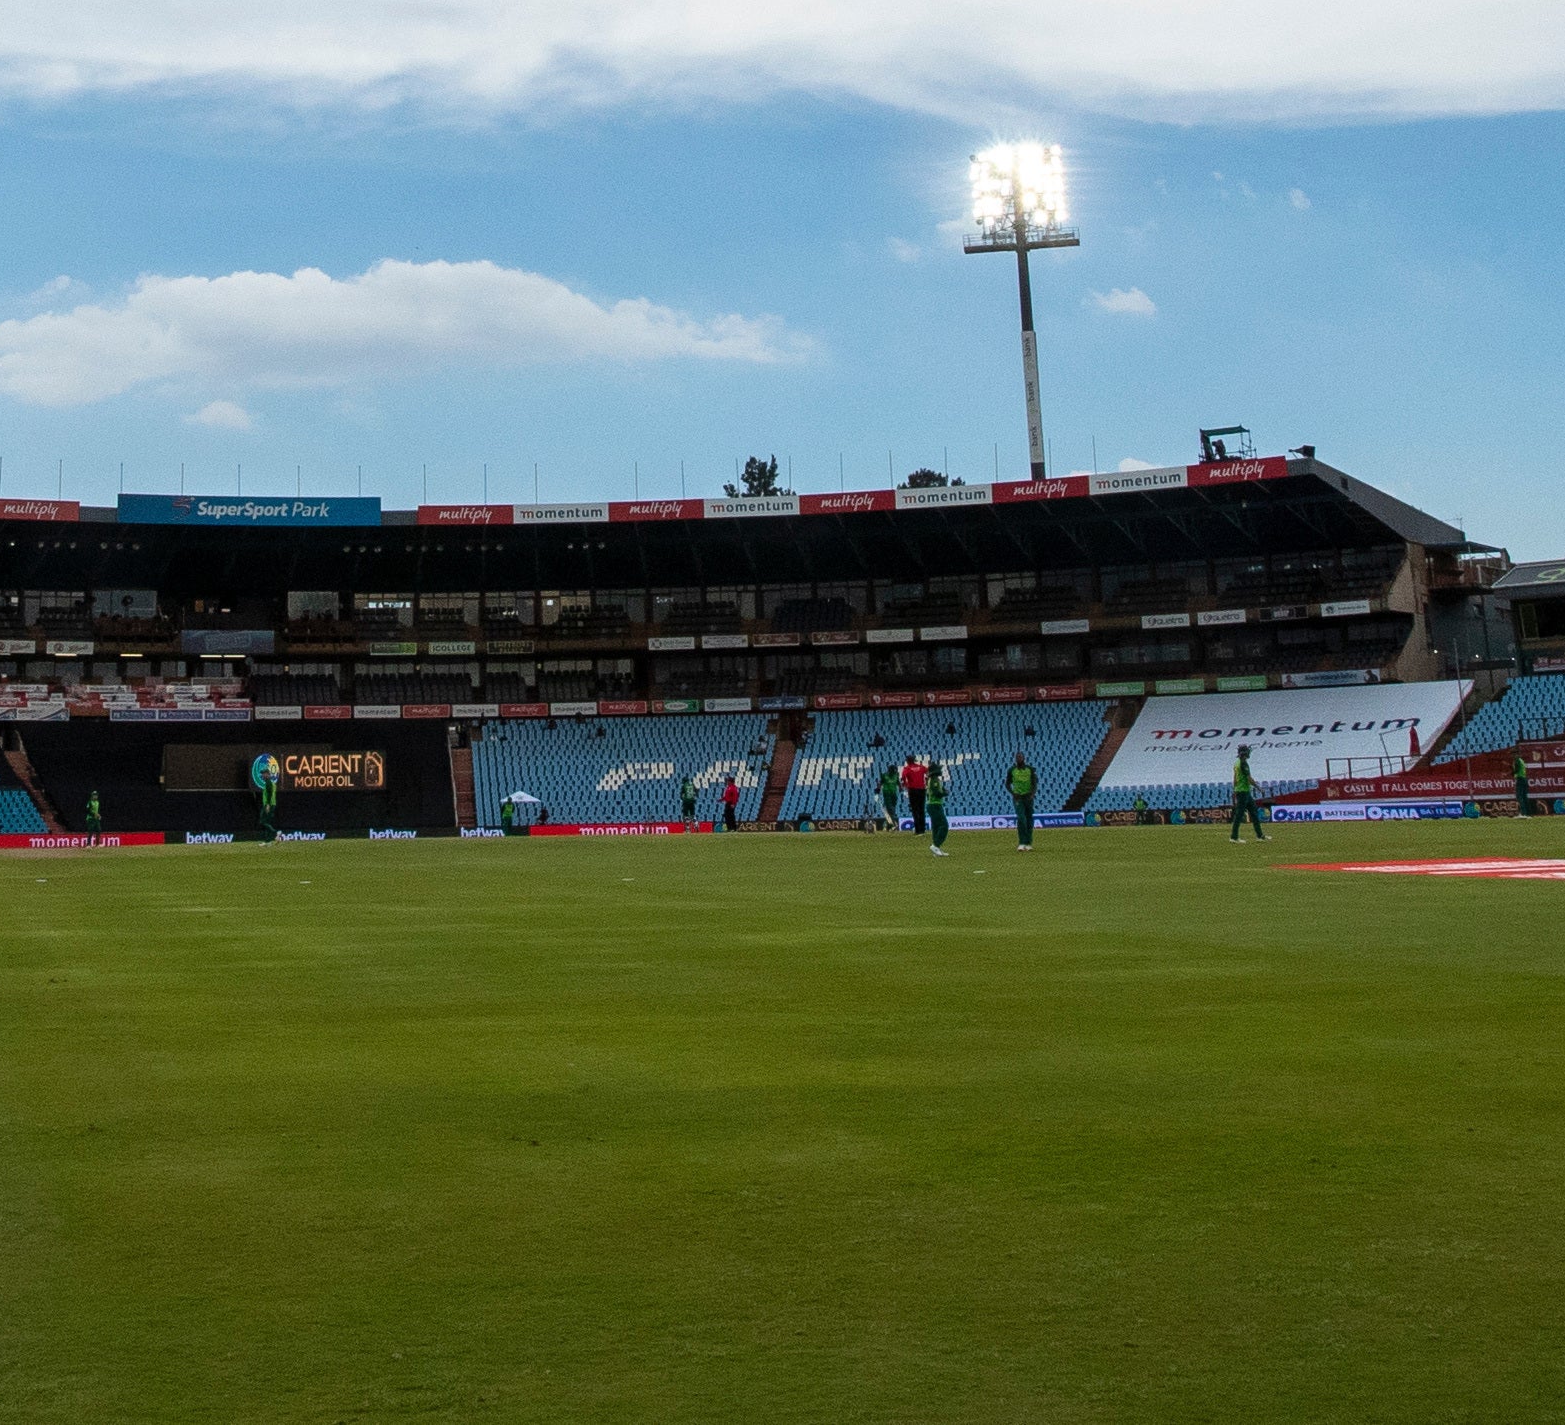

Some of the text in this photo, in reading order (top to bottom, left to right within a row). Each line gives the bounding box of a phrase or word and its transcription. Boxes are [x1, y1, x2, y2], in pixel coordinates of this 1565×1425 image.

[1210, 462, 1265, 481] multiply
[1096, 472, 1181, 490] momentum
[1014, 480, 1067, 498] multiply
[821, 493, 874, 512] multiply
[902, 490, 986, 504] momentum
[3, 502, 59, 520] multiply
[197, 501, 329, 520] SuperSport Park
[520, 507, 603, 519] momentum
[630, 501, 682, 519] multiply
[710, 500, 794, 513] momentum
[439, 507, 492, 525] multiply
[1151, 718, 1420, 739] momentum
[1144, 738, 1323, 753] medical scheme
[286, 754, 361, 774] CARIENT
[295, 776, 354, 787] MOTOR OIL
[1344, 782, 1375, 792] CASTLE
[1382, 783, 1390, 792] IT
[1392, 783, 1408, 792] ALL
[1410, 782, 1442, 791] COMES
[1494, 779, 1516, 787] WITH
[1274, 808, 1322, 821] OSAKA
[1366, 806, 1419, 819] OSAKA
[579, 825, 669, 836] momentum
[738, 822, 777, 831] ARIENT
[993, 817, 1043, 829] OSA
[186, 832, 233, 844] betway
[369, 828, 416, 840] betway
[29, 836, 120, 848] momentum
